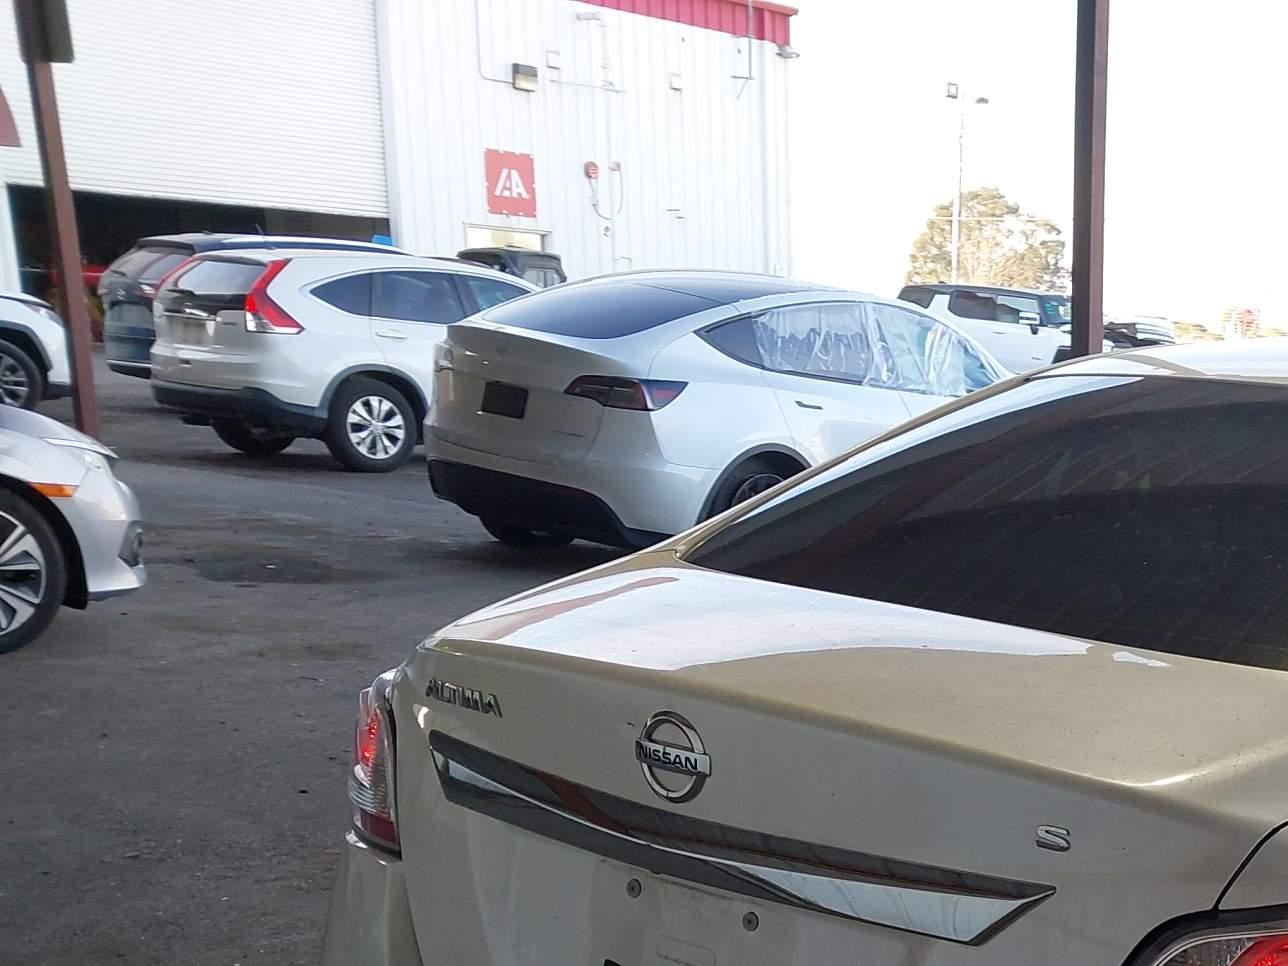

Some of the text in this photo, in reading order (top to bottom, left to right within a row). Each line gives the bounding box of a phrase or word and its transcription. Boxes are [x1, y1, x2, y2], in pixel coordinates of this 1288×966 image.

[425, 677, 503, 718] ALTIMA
[639, 744, 698, 771] NISSAN
[1035, 824, 1071, 853] S
